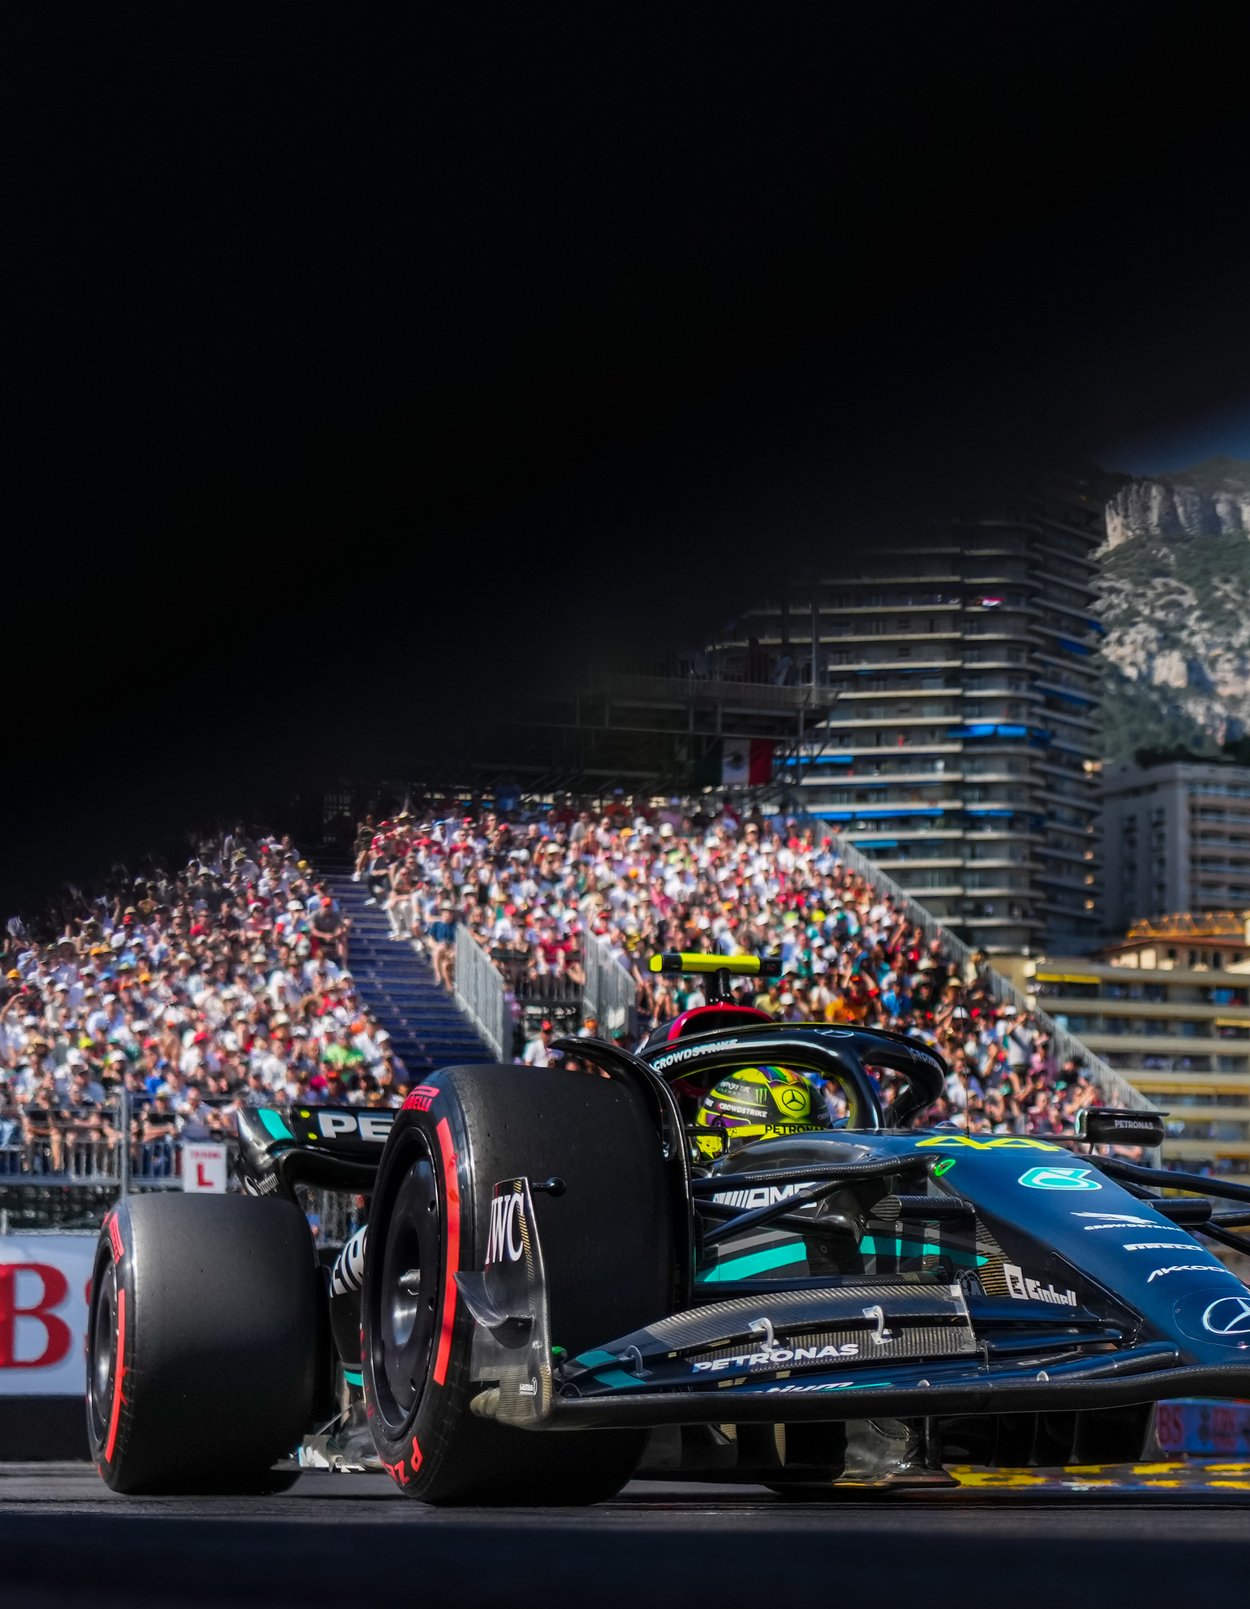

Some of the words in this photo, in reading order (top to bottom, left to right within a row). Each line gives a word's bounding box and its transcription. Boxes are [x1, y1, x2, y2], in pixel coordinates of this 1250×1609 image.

[1115, 1120, 1155, 1131] PETRONAS
[915, 1136, 1063, 1152] 44
[197, 1162, 214, 1187] L
[485, 1193, 525, 1265] IWC
[1025, 1277, 1077, 1307] Einhell
[692, 1343, 859, 1373] PETRONAS
